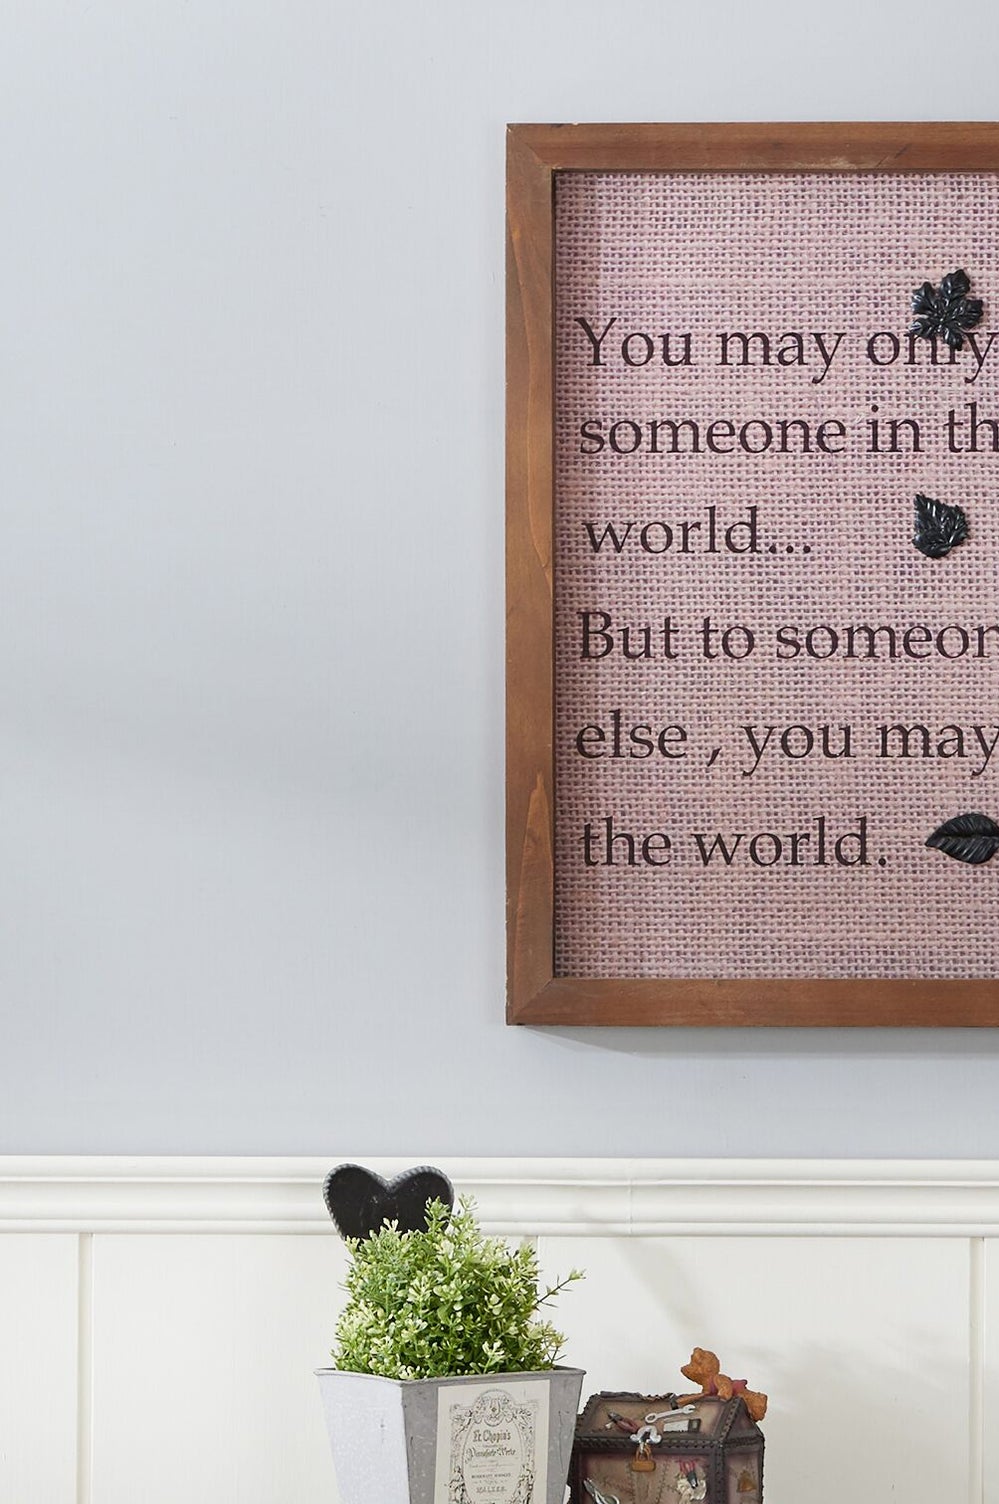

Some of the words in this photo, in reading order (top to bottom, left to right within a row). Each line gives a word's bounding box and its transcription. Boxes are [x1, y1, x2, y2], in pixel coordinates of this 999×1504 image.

[575, 316, 694, 367] You
[715, 330, 845, 384] may
[579, 417, 846, 454] someone
[867, 404, 921, 453] in
[582, 505, 812, 554] world...
[577, 611, 681, 660] But
[700, 617, 755, 660] to
[741, 724, 854, 777] you
[579, 816, 672, 867] the
[691, 816, 888, 867] world.
